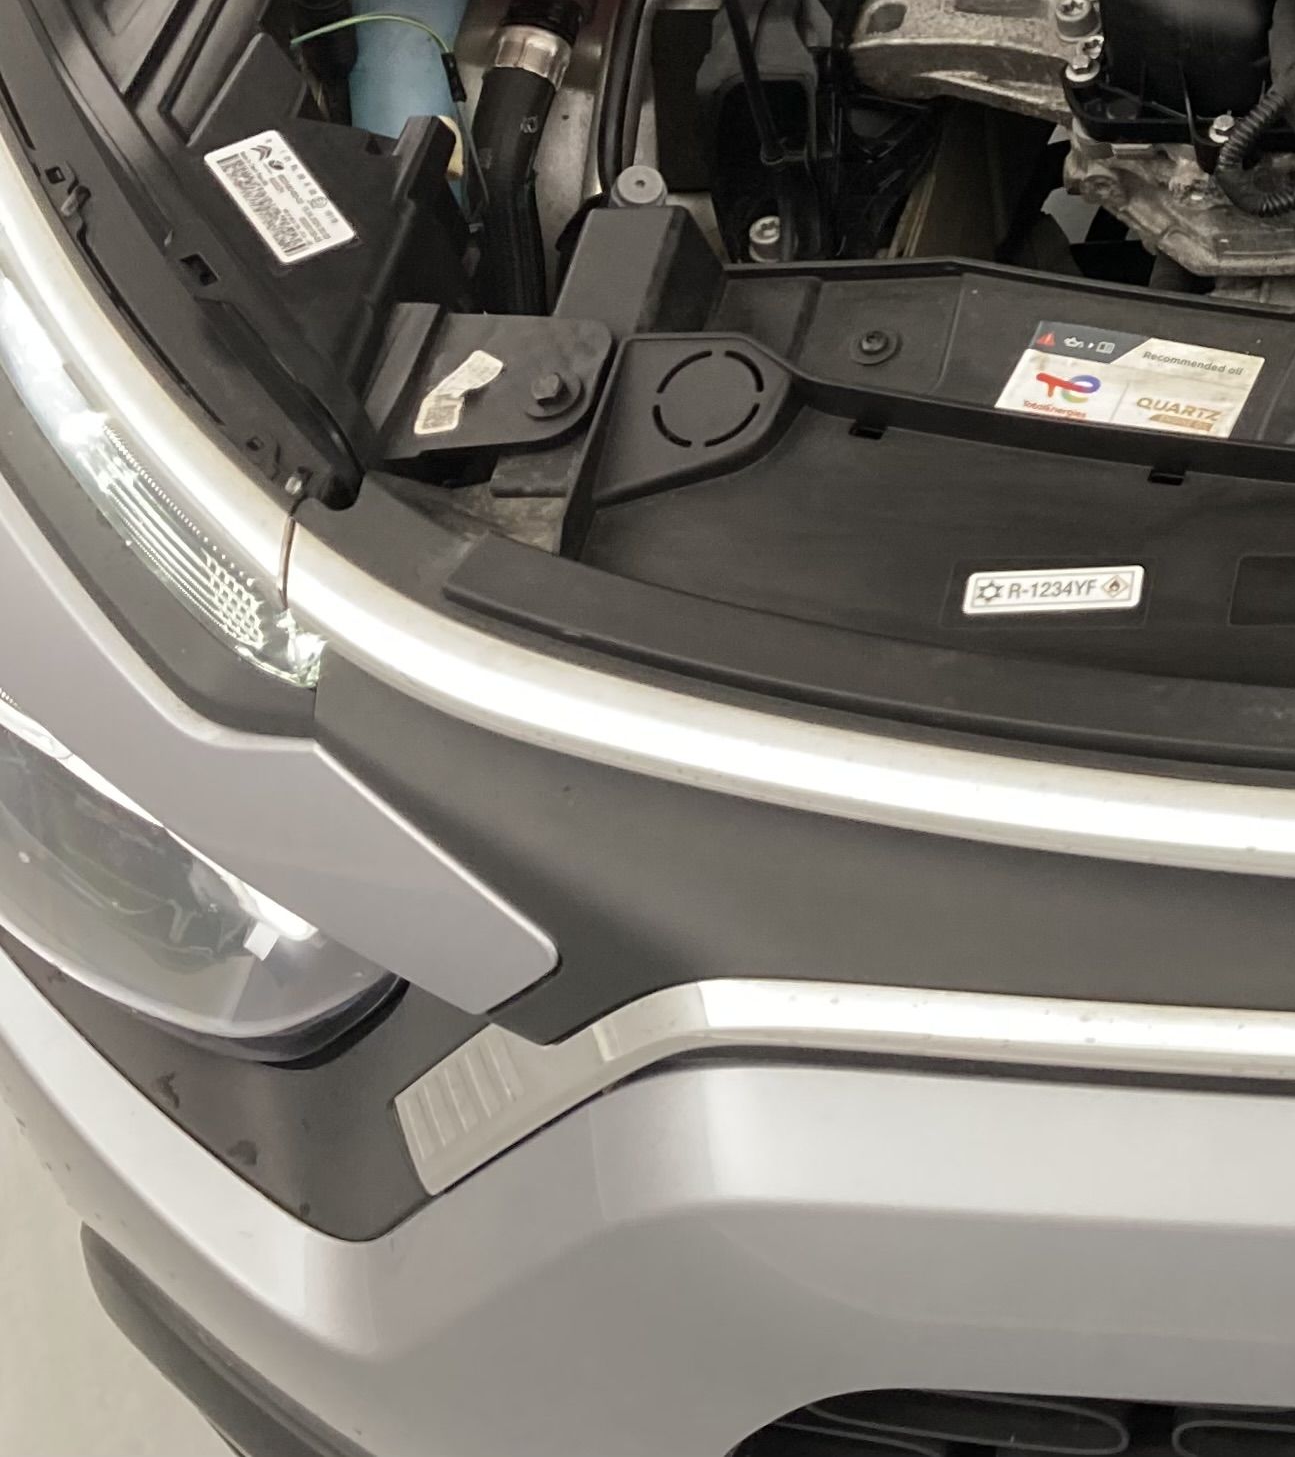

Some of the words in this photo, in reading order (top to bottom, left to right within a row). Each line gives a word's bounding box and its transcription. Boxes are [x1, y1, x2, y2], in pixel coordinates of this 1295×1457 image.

[1142, 351, 1226, 374] Recommended
[1228, 366, 1244, 376] oil
[1136, 397, 1222, 421] QUARTZ
[1008, 579, 1097, 599] R-1234YF
